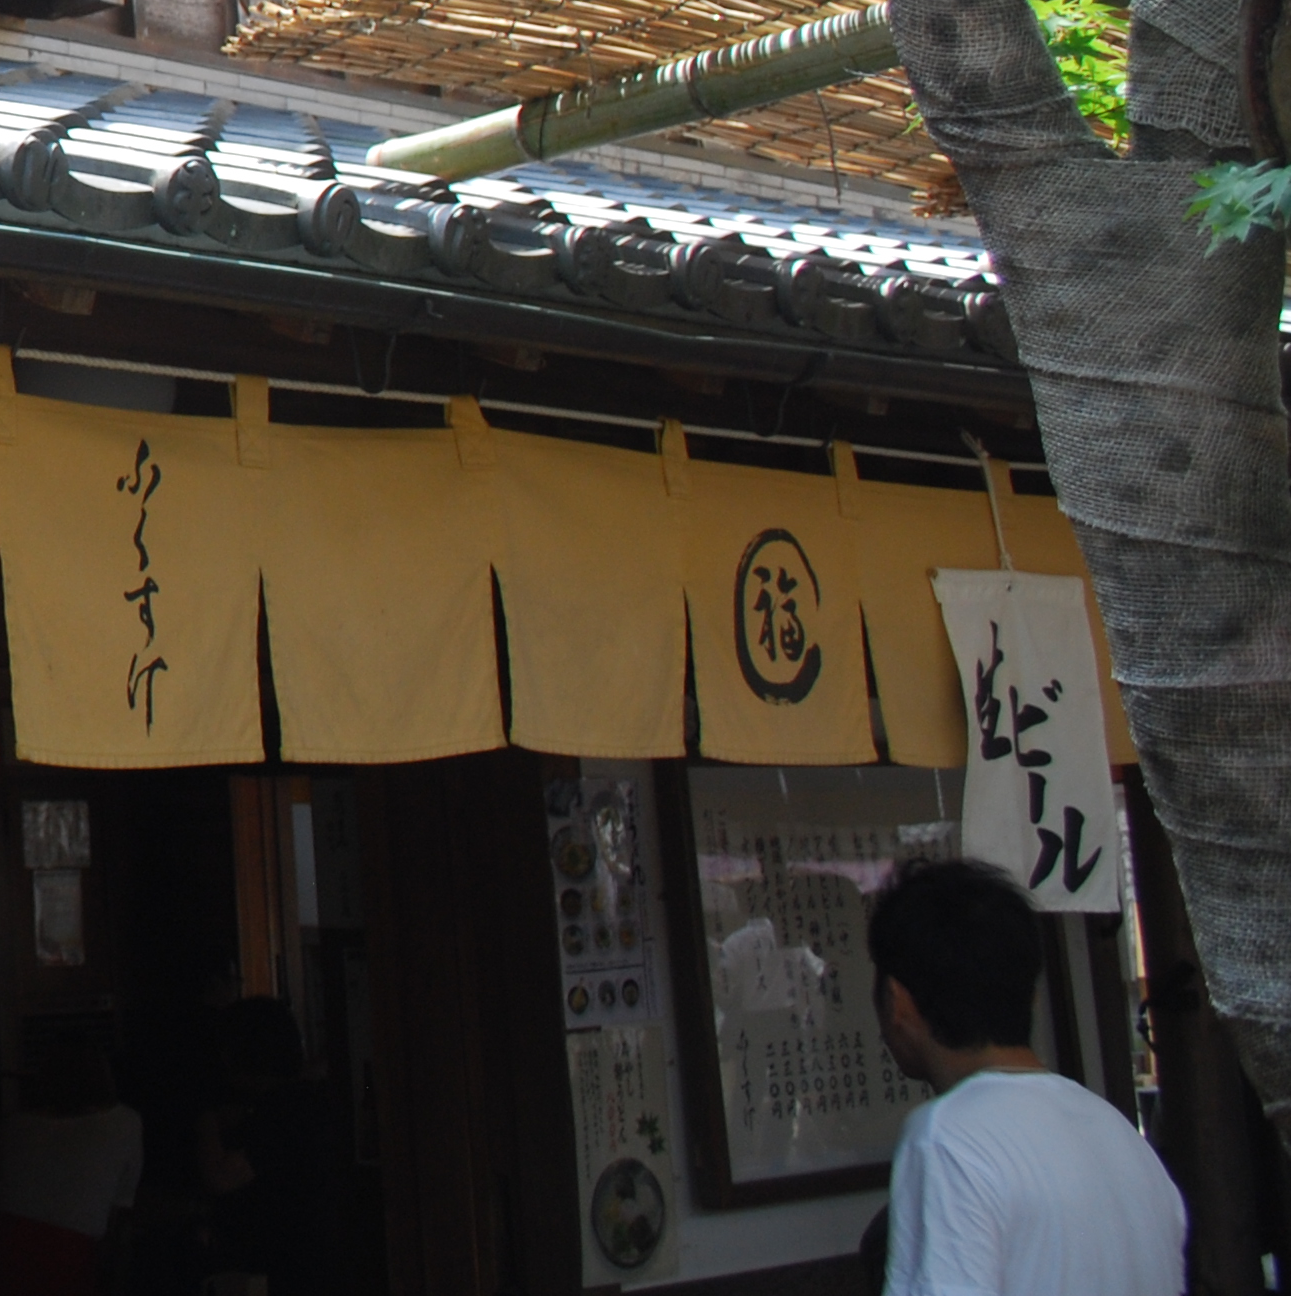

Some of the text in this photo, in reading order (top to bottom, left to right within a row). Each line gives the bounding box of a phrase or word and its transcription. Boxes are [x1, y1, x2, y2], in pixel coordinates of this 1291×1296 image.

[116, 438, 168, 738] ふくすけ
[752, 565, 805, 663] 福
[974, 619, 1103, 894] 生ビール
